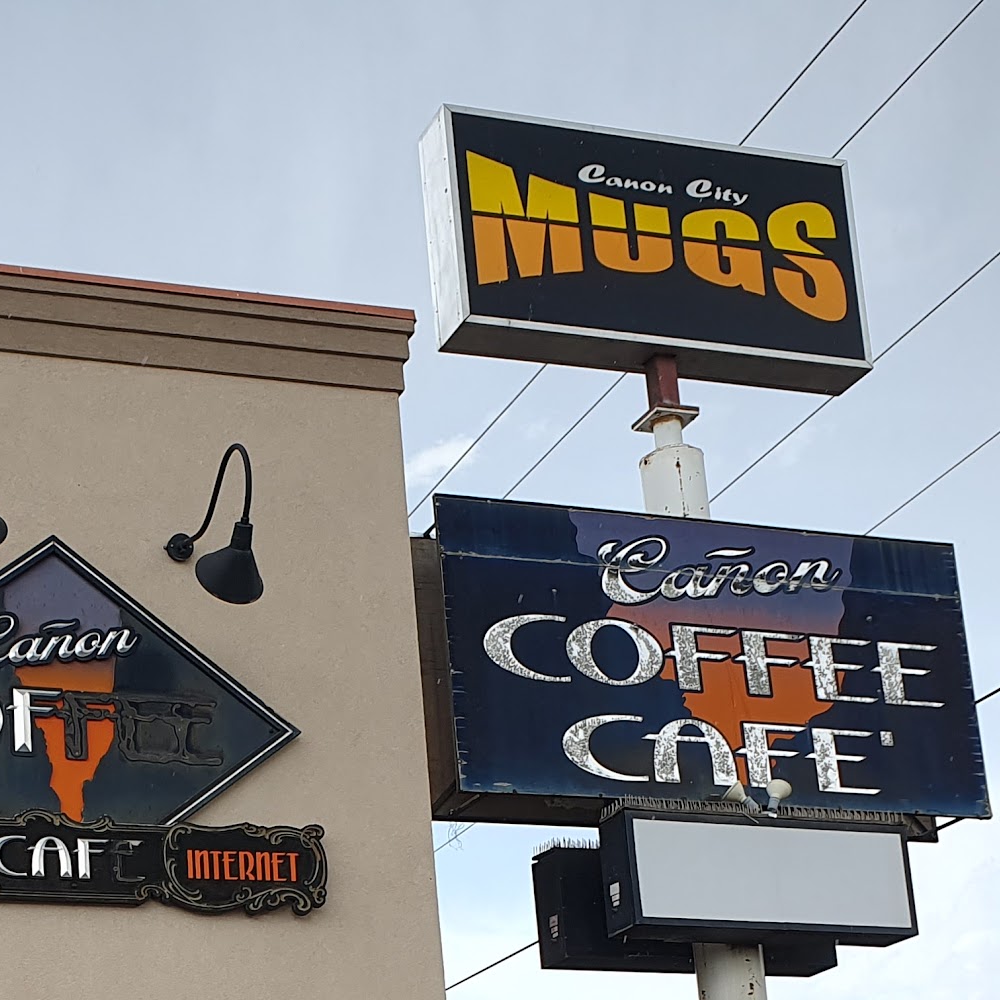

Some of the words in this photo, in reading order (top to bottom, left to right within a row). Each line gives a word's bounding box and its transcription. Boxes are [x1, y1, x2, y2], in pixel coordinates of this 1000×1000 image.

[578, 164, 673, 195] Canon
[685, 178, 749, 206] City
[465, 149, 848, 322] MUGS
[597, 535, 840, 605] Cañon
[482, 613, 946, 709] COFFEE
[186, 848, 300, 883] INTERNET
